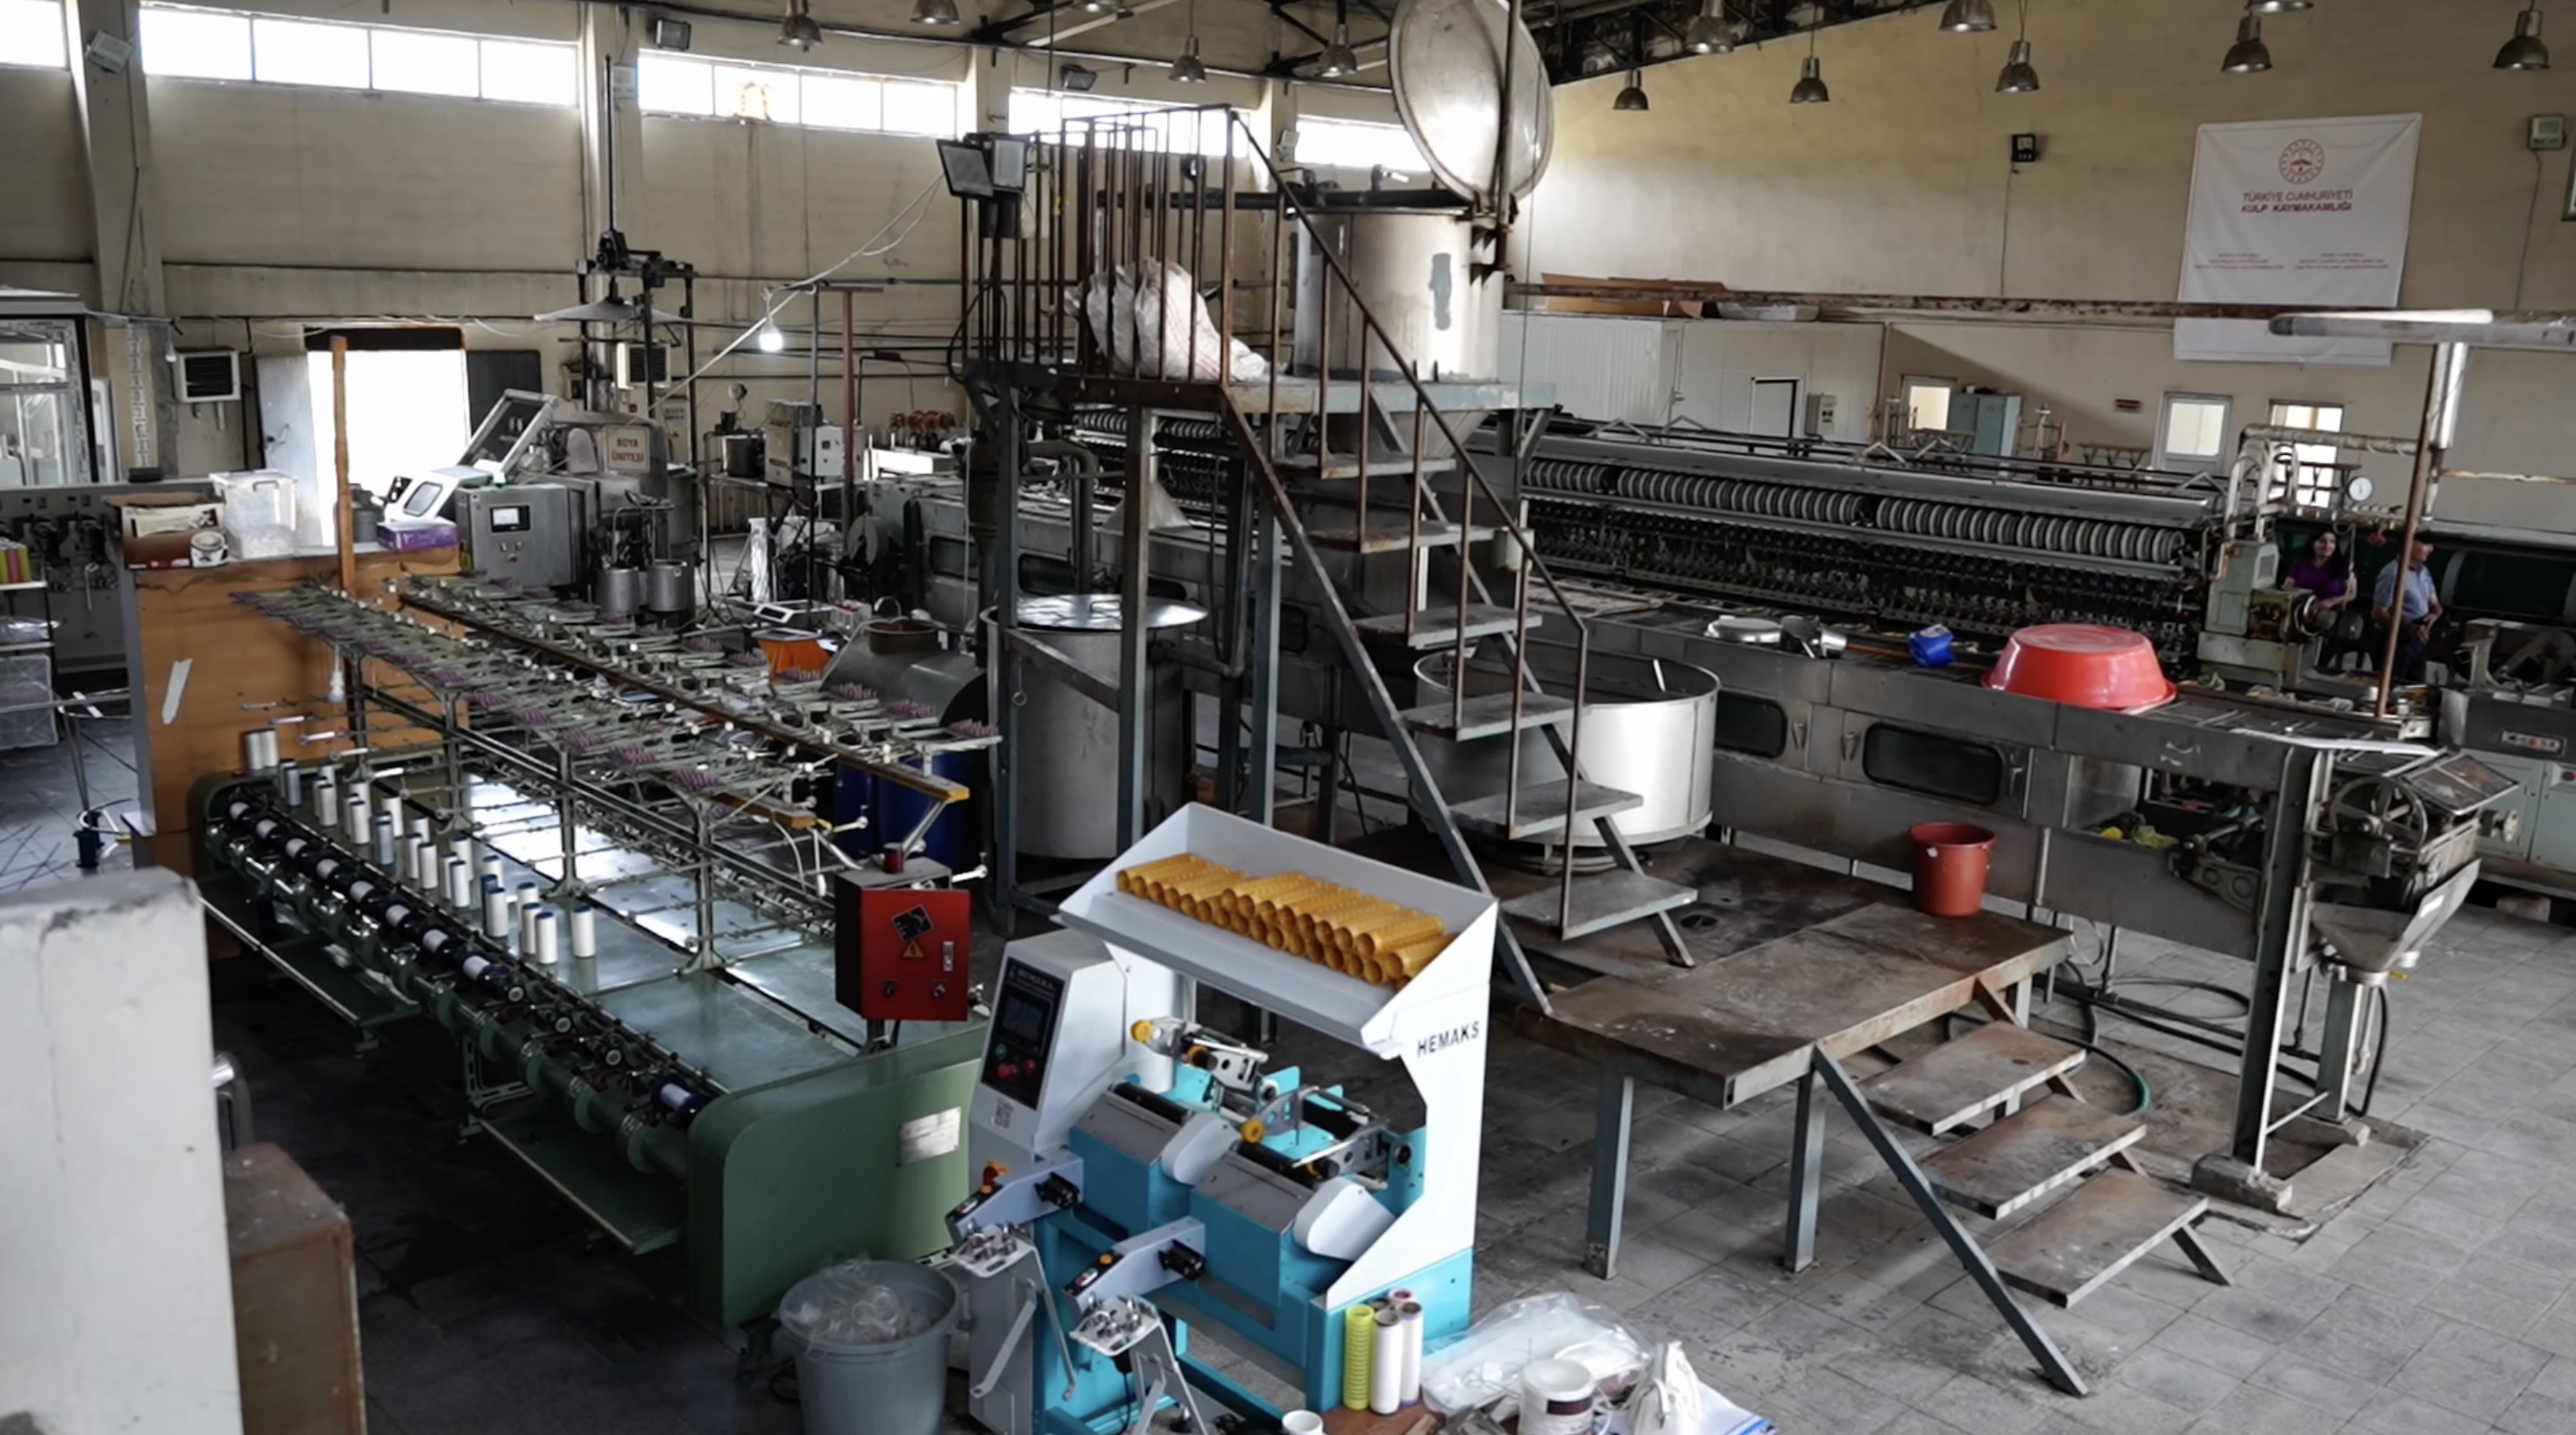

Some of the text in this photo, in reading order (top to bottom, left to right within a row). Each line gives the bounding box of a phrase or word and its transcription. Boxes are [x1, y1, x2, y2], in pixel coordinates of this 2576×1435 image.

[2243, 187, 2353, 202] TÜRKİYE CUMHURİYETİ
[2241, 201, 2352, 213] KULP KAYMAKAMLIĞI
[617, 438, 639, 448] BOYA
[1417, 1020, 1479, 1058] HEMAKS
